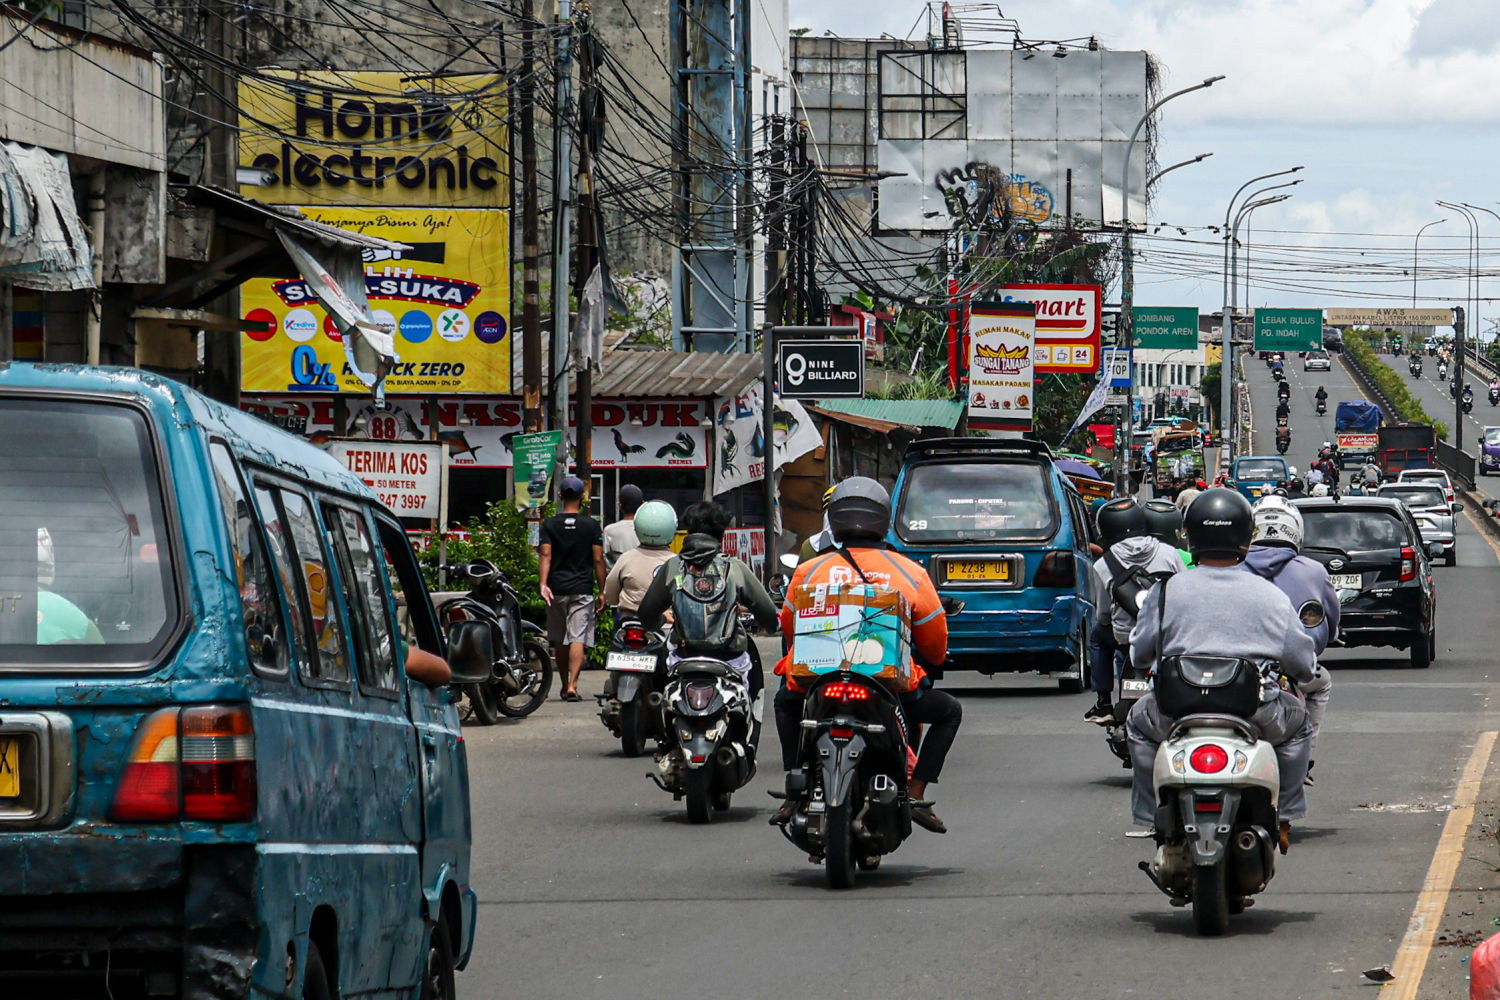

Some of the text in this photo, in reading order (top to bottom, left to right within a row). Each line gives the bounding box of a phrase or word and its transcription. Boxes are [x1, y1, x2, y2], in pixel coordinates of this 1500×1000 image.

[296, 91, 453, 140] Home
[252, 143, 497, 189] electronic
[376, 215, 417, 227] Disini
[423, 215, 452, 234] Aja!
[1261, 316, 1315, 325] LEBAK BULUS
[975, 326, 1031, 340] RUMAH MAKAN
[1172, 328, 1193, 336] AREN
[1276, 329, 1300, 337] INDAH
[291, 344, 336, 385] 0%
[808, 360, 835, 368] NINE
[974, 355, 1031, 371] SUNGAI TANANG
[418, 362, 465, 377] ZERO
[808, 371, 857, 380] BILLIARD
[1111, 365, 1127, 375] TOP
[1005, 380, 1031, 388] PADANG
[371, 417, 396, 440] 88
[523, 435, 553, 444] GrabCar
[347, 450, 428, 475] TERIMA KOS
[526, 453, 540, 465] 15
[377, 480, 417, 489] 50 METER
[401, 495, 427, 509] 3997
[909, 519, 928, 531] 29
[948, 561, 1007, 574] B 2238 UL
